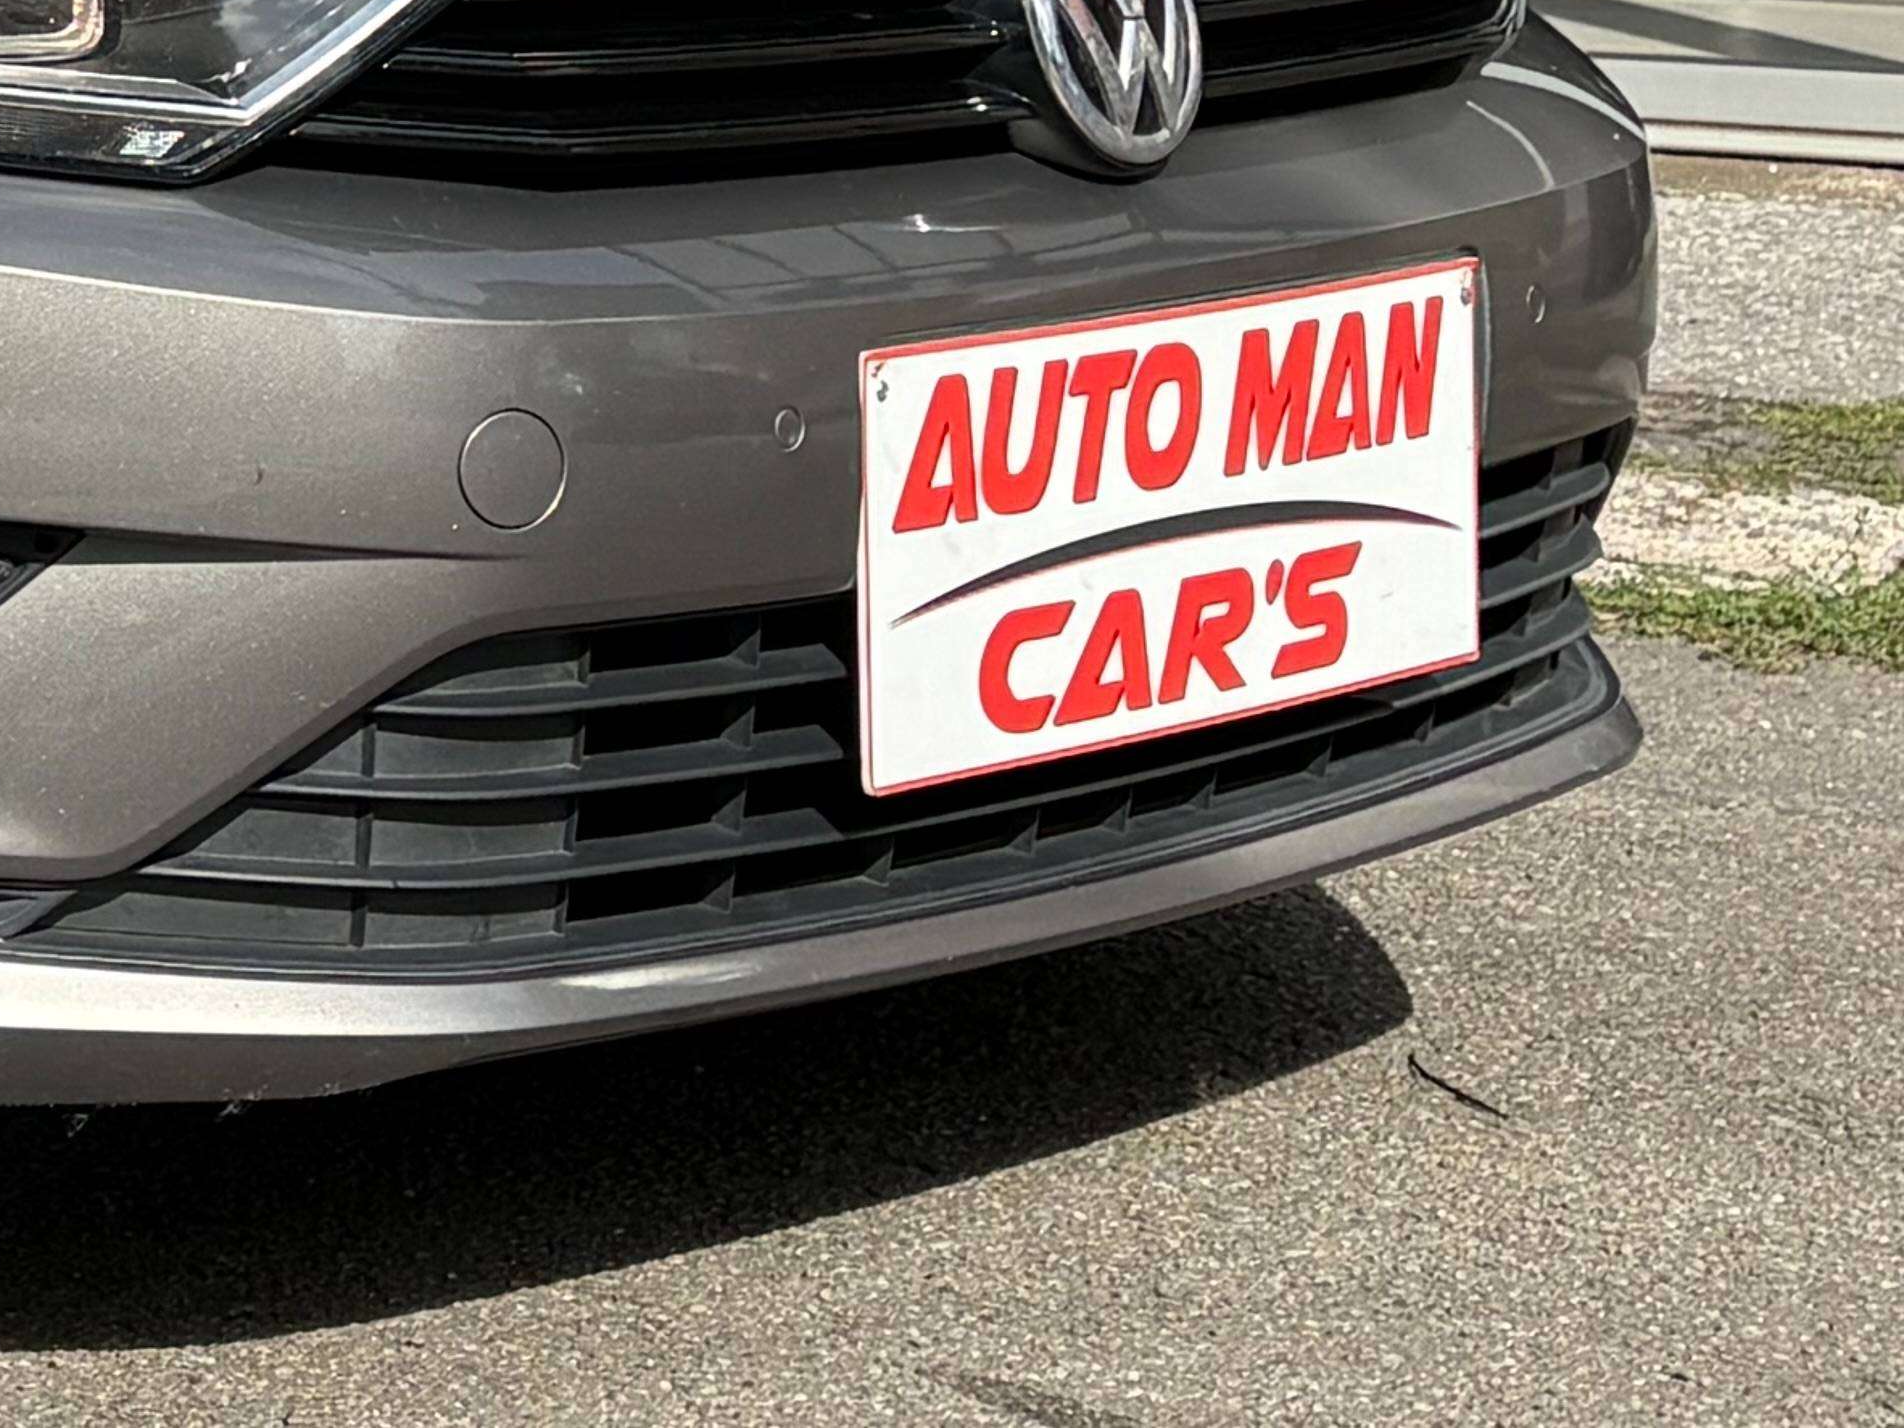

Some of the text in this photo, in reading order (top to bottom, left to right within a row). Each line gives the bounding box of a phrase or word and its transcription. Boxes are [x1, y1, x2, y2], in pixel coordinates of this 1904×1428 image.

[891, 294, 1445, 534] AUTO MAN
[977, 540, 1364, 734] CAR'S
